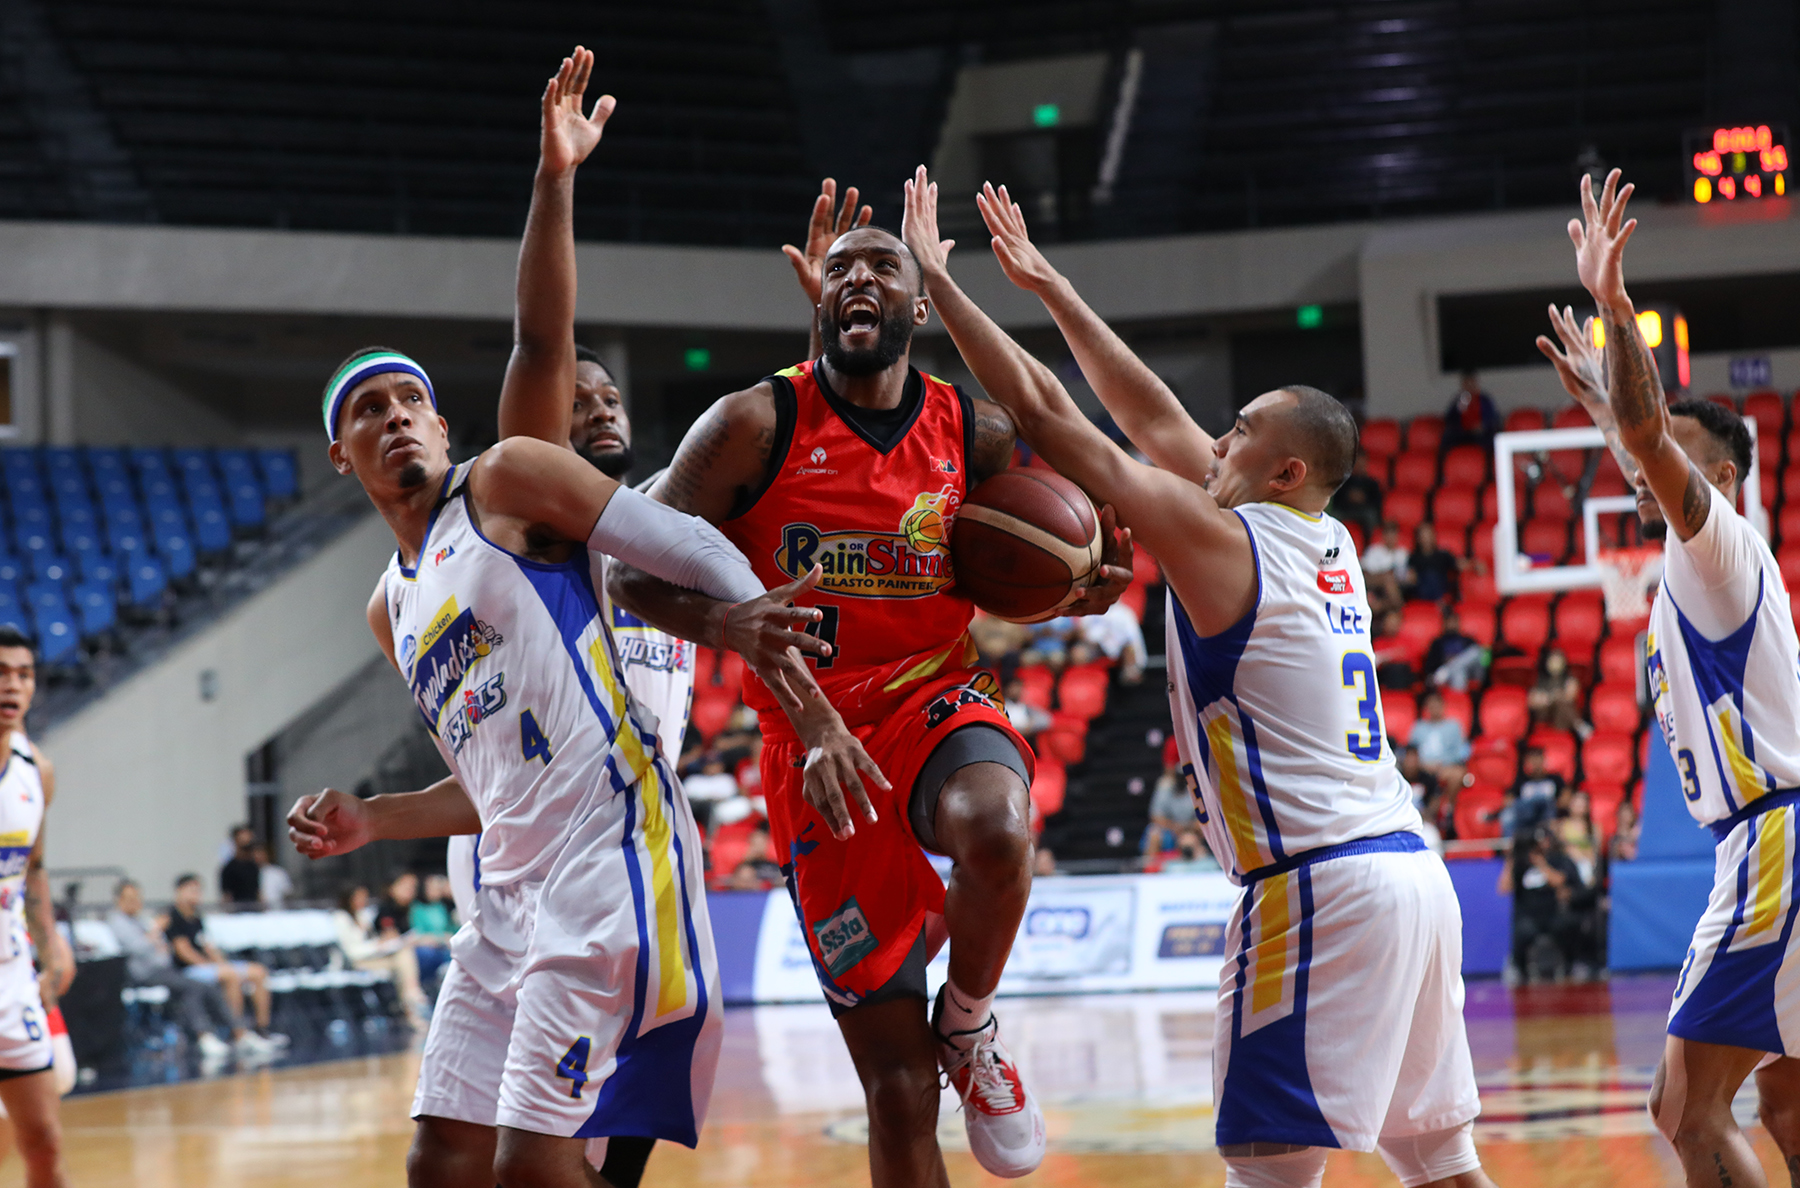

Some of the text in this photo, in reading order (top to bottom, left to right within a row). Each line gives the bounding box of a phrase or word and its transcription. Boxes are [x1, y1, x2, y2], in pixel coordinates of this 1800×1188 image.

[785, 525, 866, 576] Rain
[850, 543, 864, 551] OR
[823, 577, 874, 588] ELASTO
[877, 579, 934, 591] PAINTER
[423, 612, 452, 645] Chicken
[1325, 602, 1365, 634] LEE
[1341, 650, 1382, 764] 3
[519, 708, 553, 767] 4
[820, 917, 865, 955] Sista
[555, 1035, 592, 1099] 4
